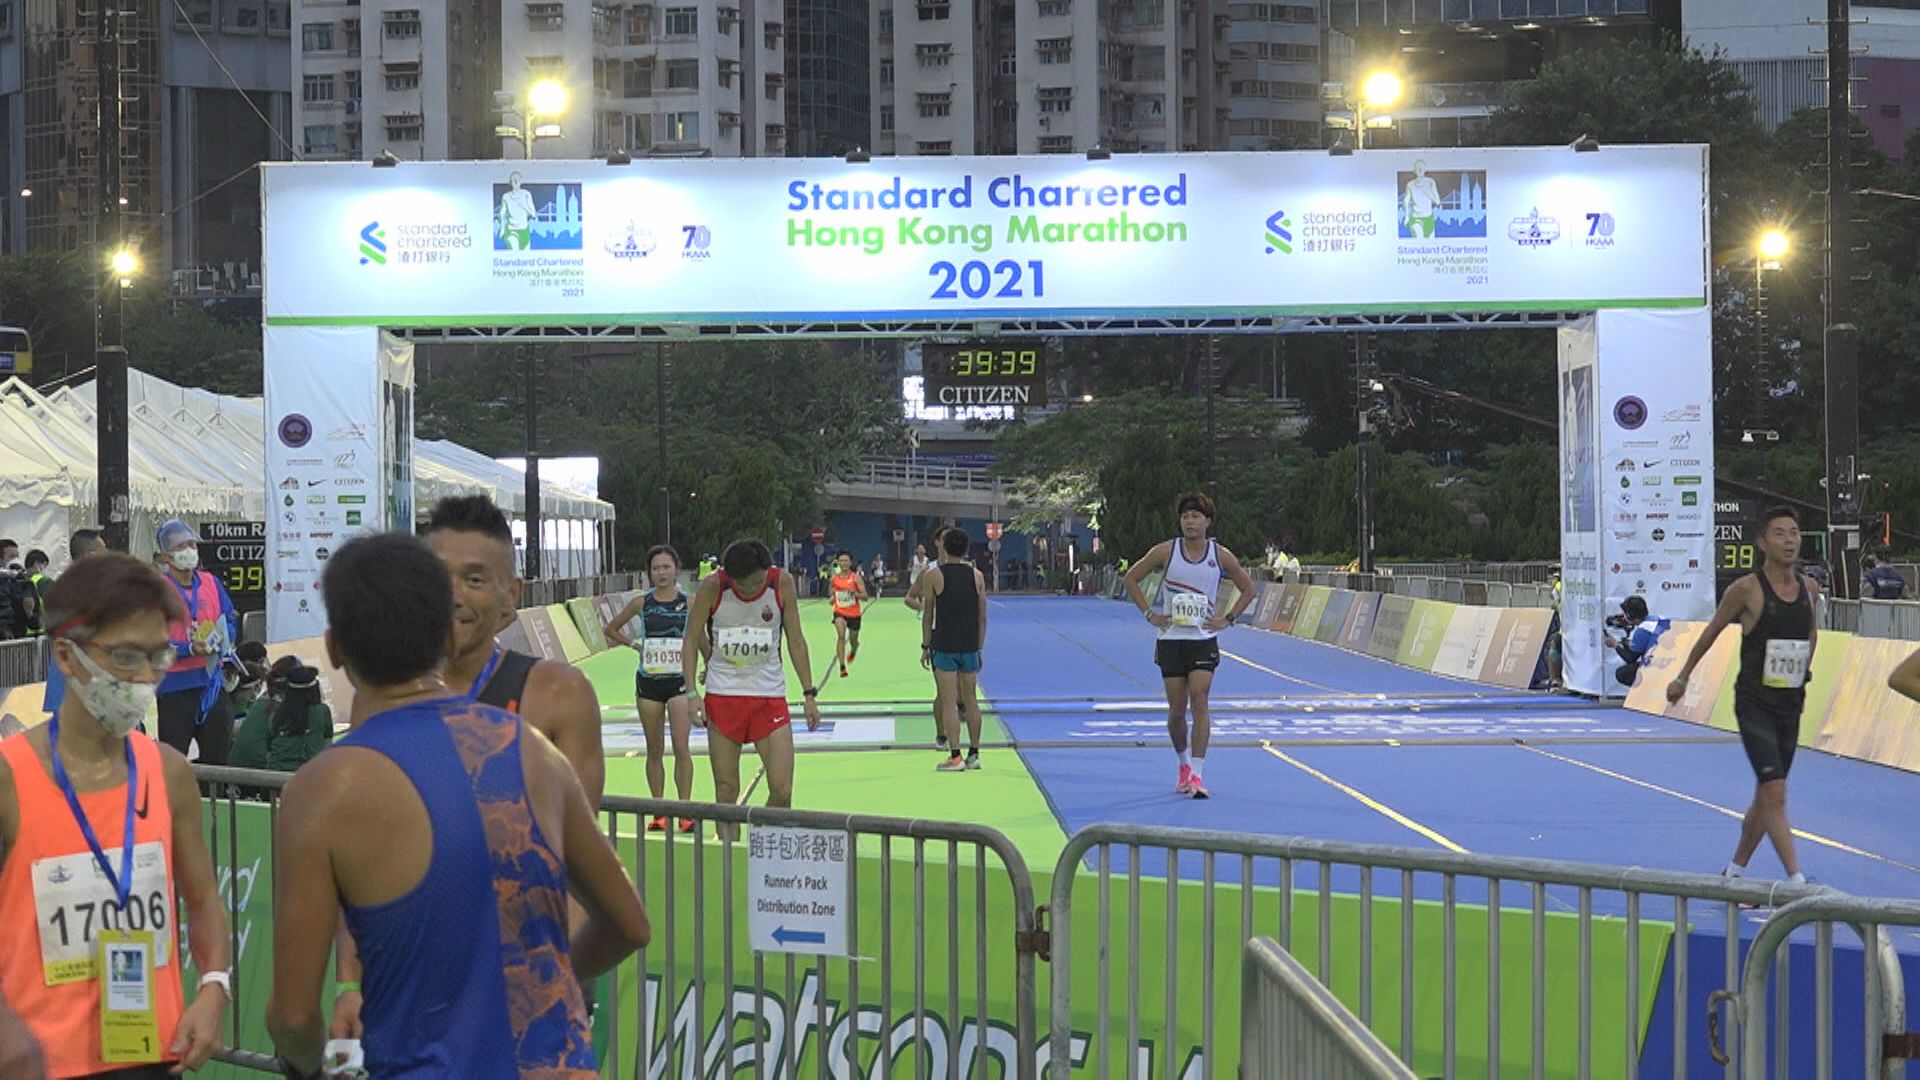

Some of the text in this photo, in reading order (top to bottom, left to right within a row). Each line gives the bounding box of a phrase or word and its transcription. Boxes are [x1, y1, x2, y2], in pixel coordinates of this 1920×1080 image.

[787, 173, 1187, 210] Standard Chartered
[1302, 210, 1372, 224] standard
[1585, 212, 1615, 236] 70
[397, 223, 468, 235] standard
[682, 224, 711, 249] 70
[786, 211, 1187, 254] Hong Kong Marathon
[1302, 223, 1377, 238] chartered
[397, 235, 472, 249] chartered
[1397, 244, 1488, 255] Standard Chartered
[492, 257, 535, 267] Standard
[1397, 255, 1489, 266] Hong Kong Marathon
[928, 259, 1044, 300] 2021
[1466, 275, 1489, 285] 2021
[561, 287, 585, 297] 2021
[938, 384, 1031, 405] CITIZEN
[207, 523, 248, 537] 10km
[251, 523, 265, 537] R
[721, 642, 769, 657] 17014
[646, 650, 682, 665] 91030
[749, 831, 845, 862] 跑手包派發區
[763, 873, 828, 891] Runner's Pack
[757, 898, 836, 917] Distribution Zone
[50, 890, 167, 946] 17006
[141, 1036, 150, 1054] 1
